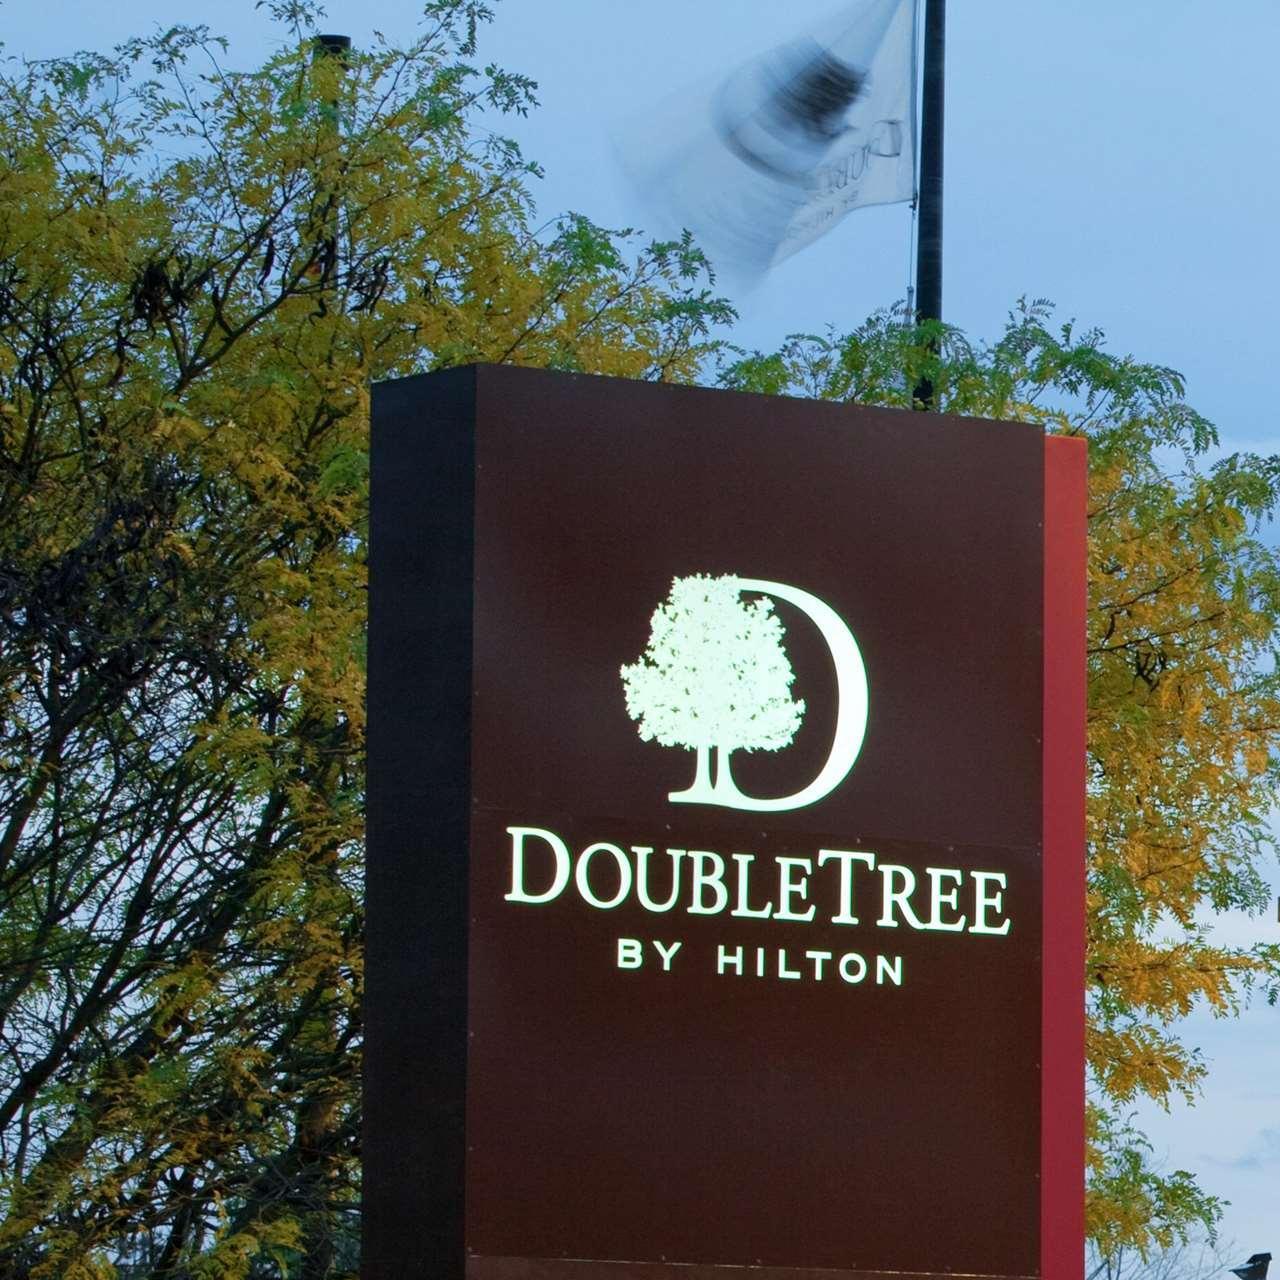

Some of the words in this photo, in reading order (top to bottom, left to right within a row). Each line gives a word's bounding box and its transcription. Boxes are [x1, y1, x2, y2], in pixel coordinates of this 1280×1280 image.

[503, 826, 1011, 936] DOUBLETREE
[617, 938, 683, 971] BY
[716, 945, 903, 986] HILTON
